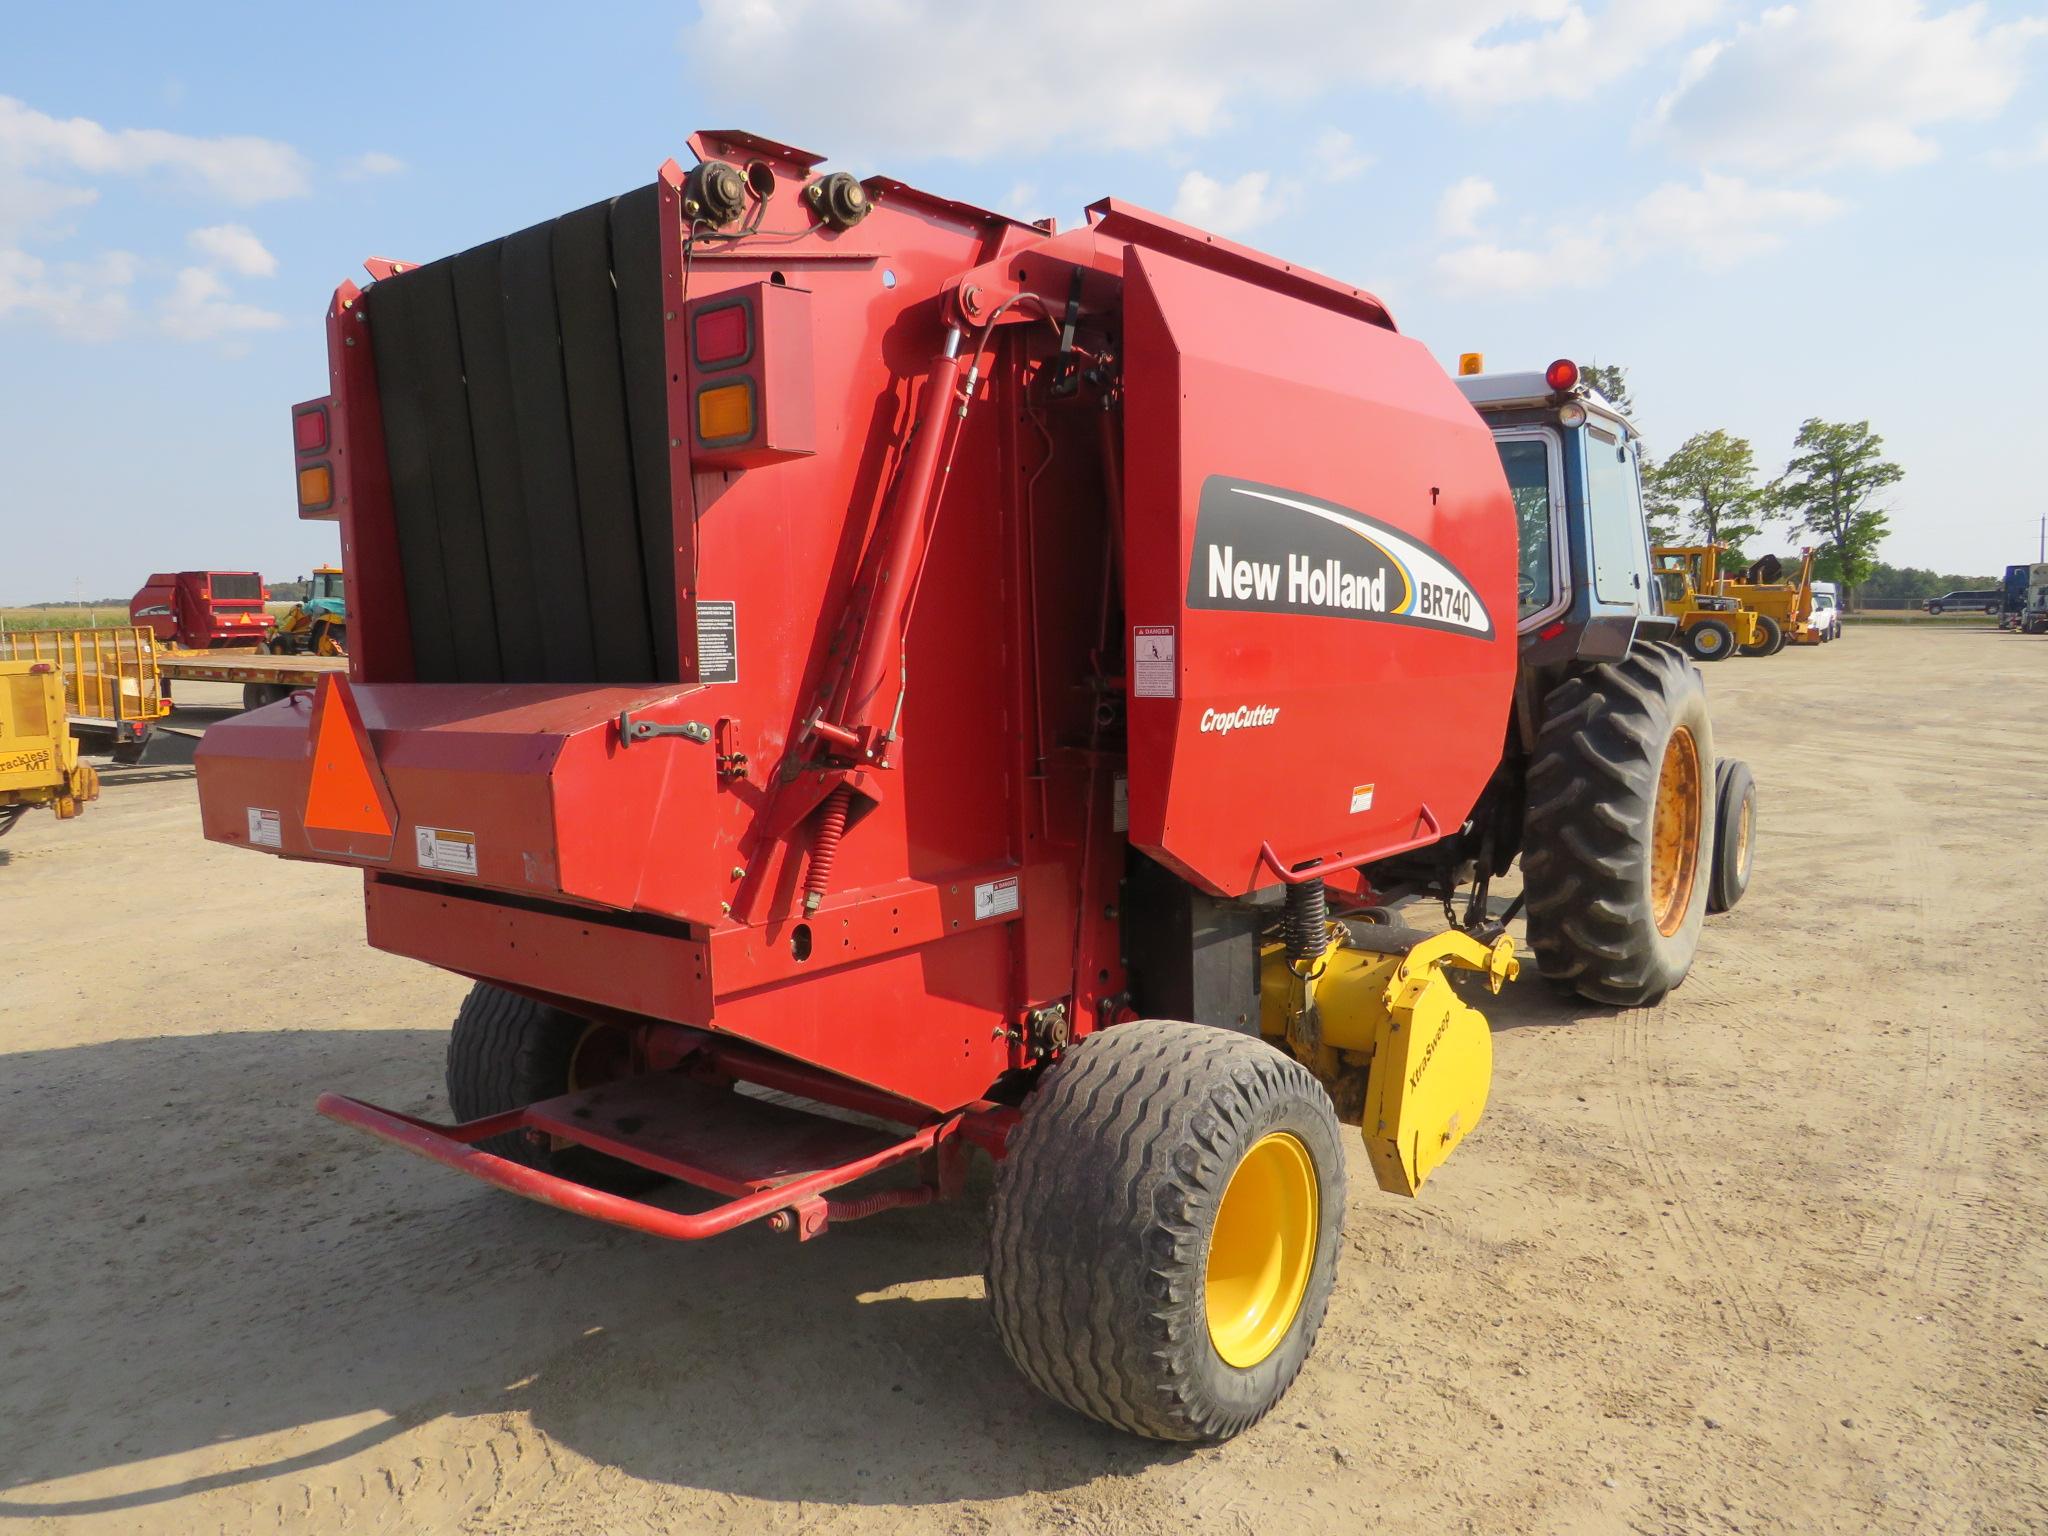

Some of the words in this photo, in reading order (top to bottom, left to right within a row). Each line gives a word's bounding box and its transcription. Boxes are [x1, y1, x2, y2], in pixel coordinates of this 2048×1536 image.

[1208, 544, 1281, 601] New
[1288, 553, 1386, 613] Holland
[1420, 581, 1471, 623] BR740
[1200, 704, 1280, 735] CropCutter
[26, 759, 50, 771] MT
[1409, 1010, 1450, 1096] XtraSweep
